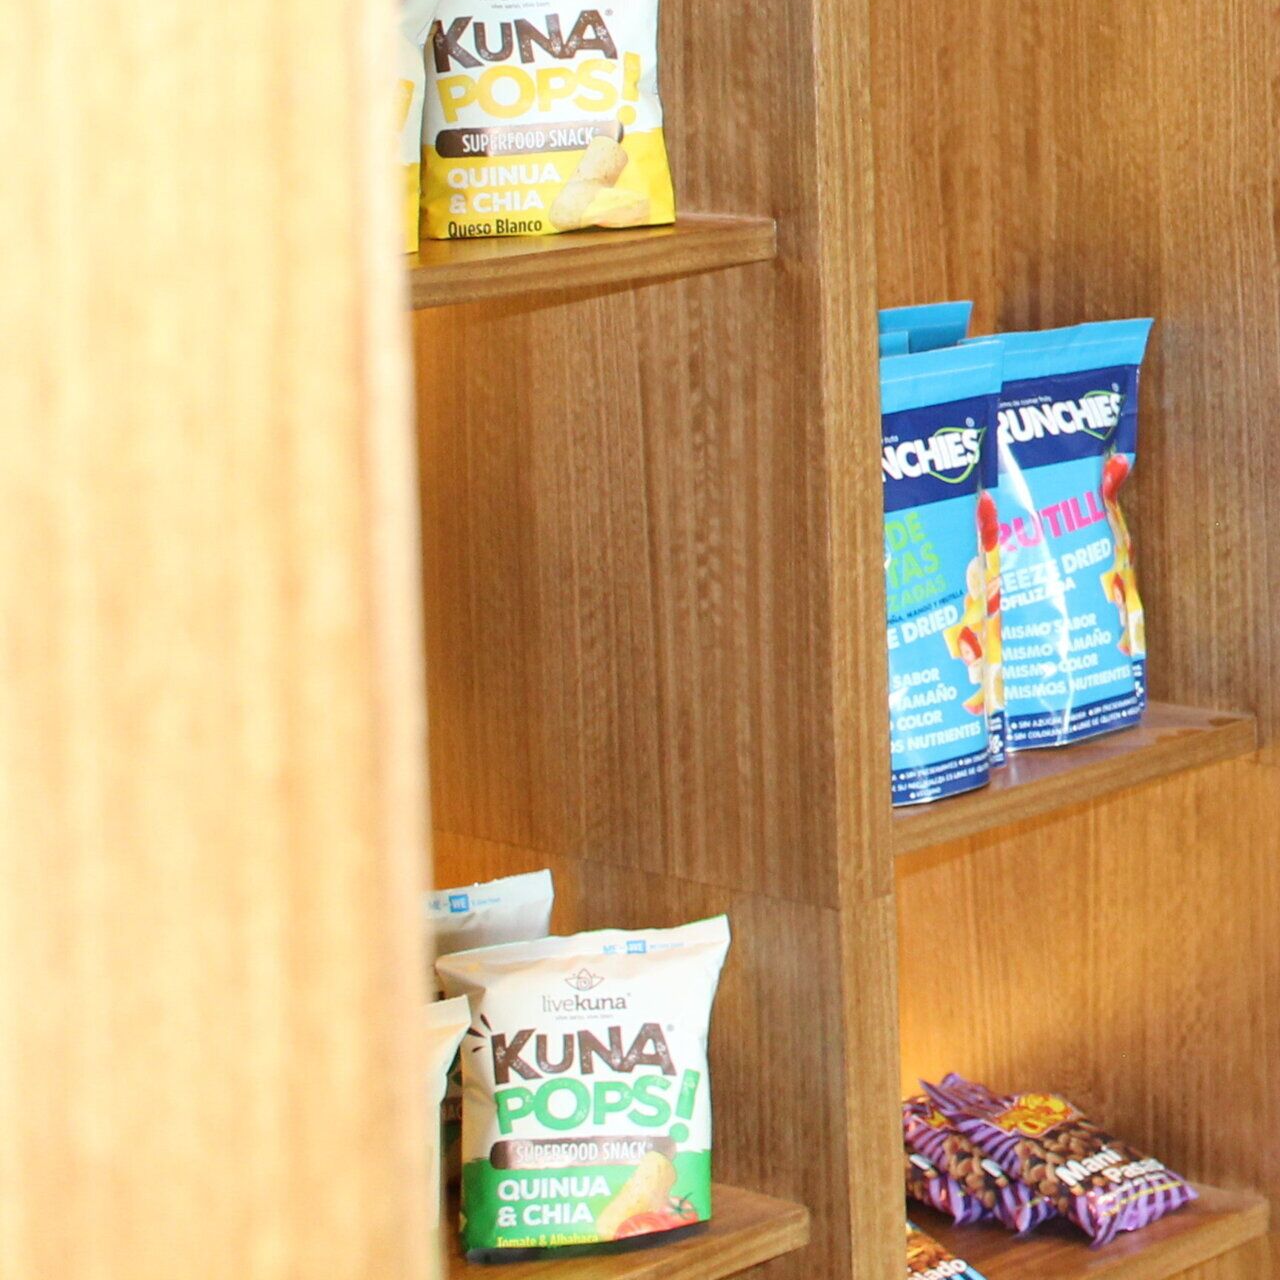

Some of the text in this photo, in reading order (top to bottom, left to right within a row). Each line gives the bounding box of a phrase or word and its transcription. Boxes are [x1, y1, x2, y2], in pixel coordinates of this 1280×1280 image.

[432, 10, 618, 73] KUNA
[436, 52, 642, 125] POPS!
[462, 127, 594, 153] SUPERFOOD SNACK
[447, 164, 562, 189] QUINUA
[448, 190, 545, 214] & CHIA
[448, 218, 543, 238] Queso Blanco
[1061, 538, 1111, 574] DRIED
[901, 604, 959, 645] DRIED
[1059, 653, 1098, 673] COLOR
[892, 667, 940, 689] SABOR
[897, 710, 943, 731] COLOR
[907, 720, 982, 752] NUTRIENTES
[541, 994, 628, 1013] livekuna
[491, 1022, 676, 1084] KUNA
[494, 1069, 700, 1143] POPS!
[516, 1141, 647, 1162] SUPERFOOD SNACK
[497, 1175, 611, 1200] QUINUA
[497, 1202, 594, 1227] & CHIA
